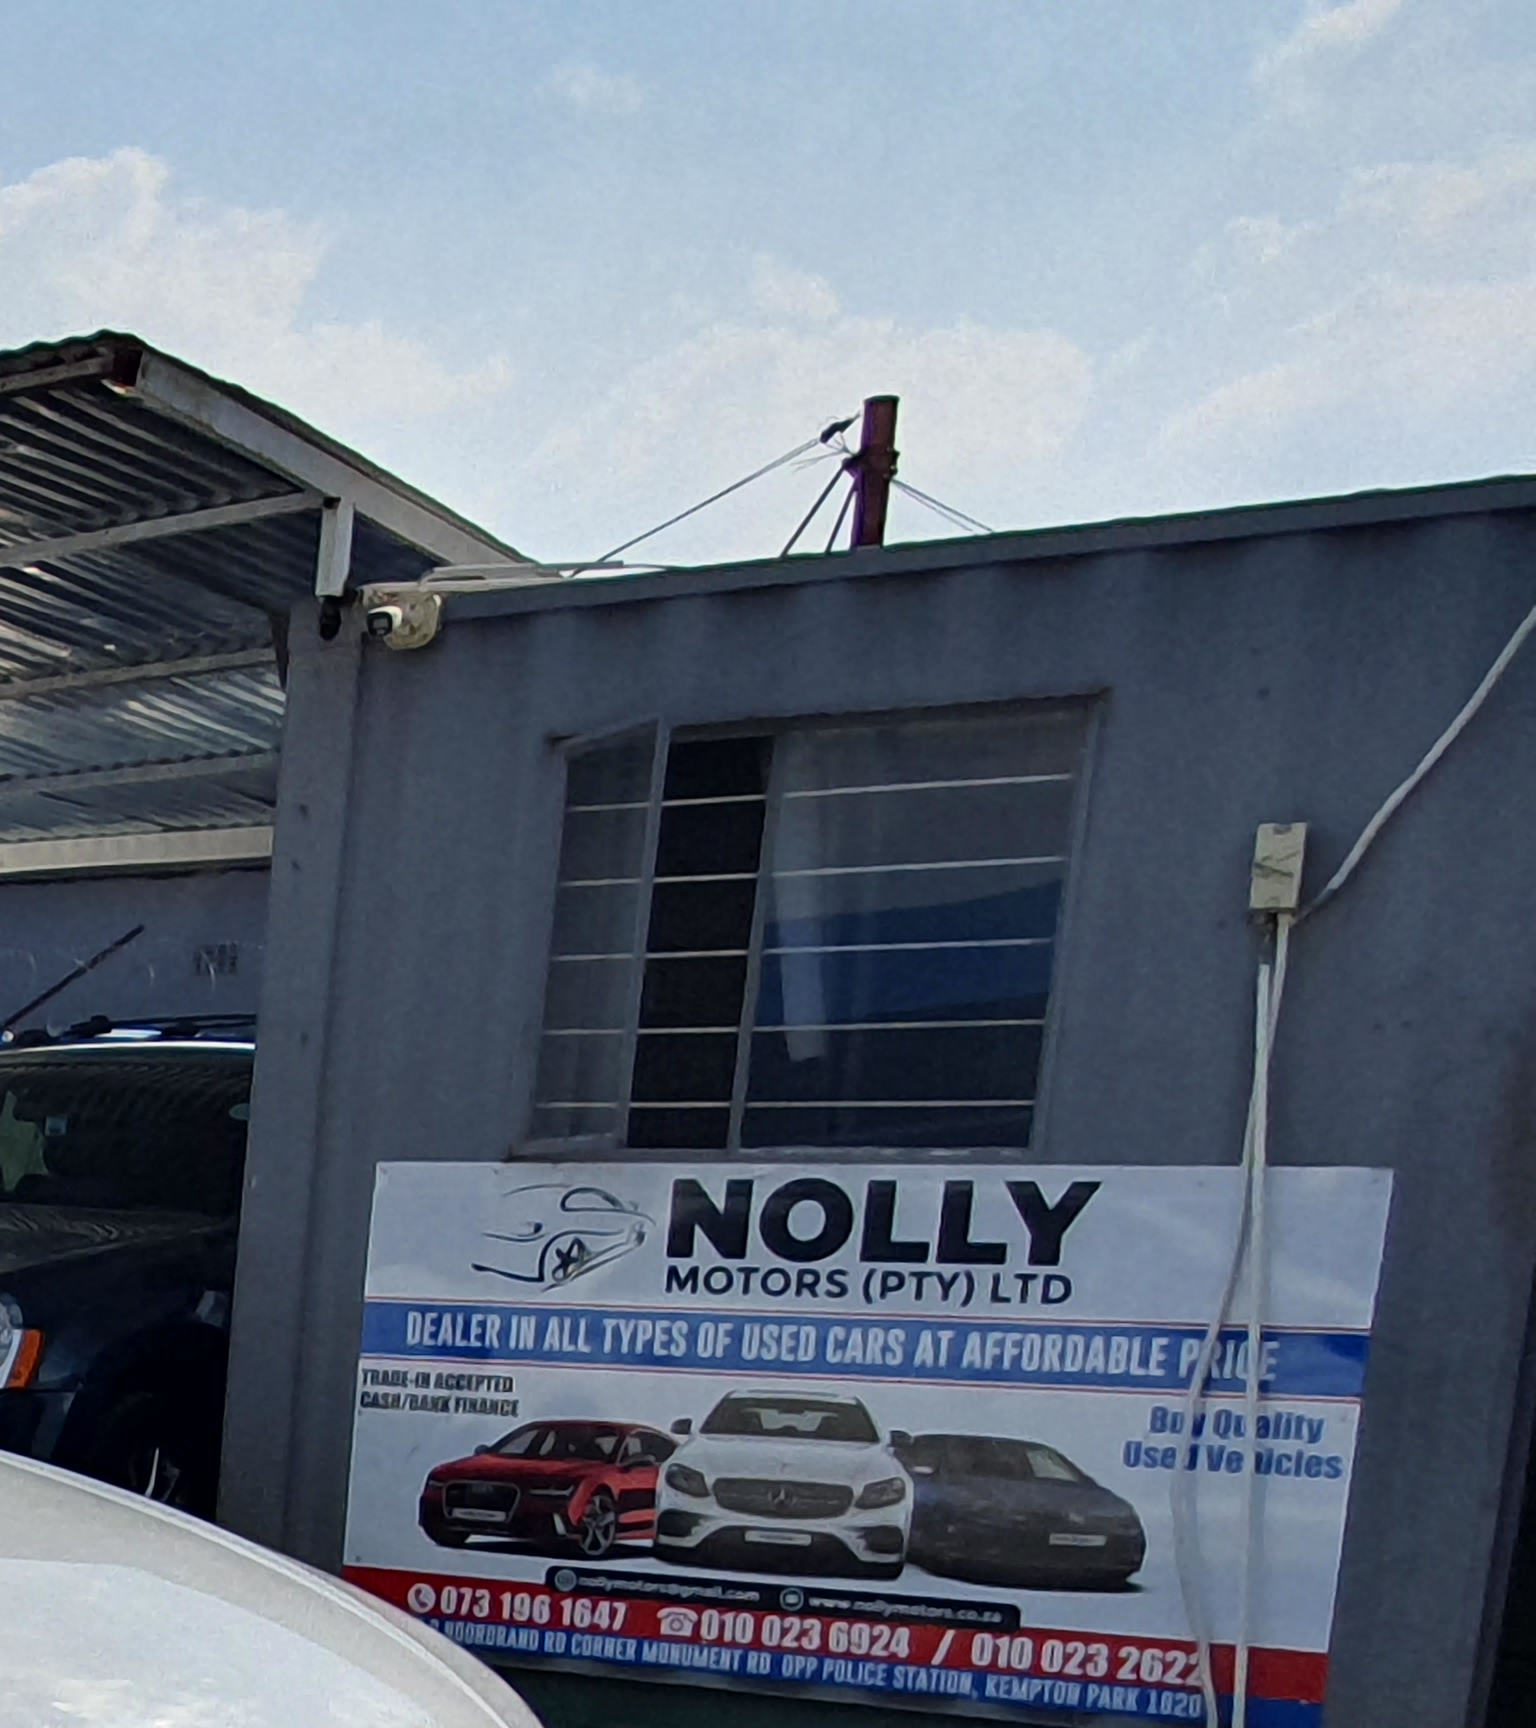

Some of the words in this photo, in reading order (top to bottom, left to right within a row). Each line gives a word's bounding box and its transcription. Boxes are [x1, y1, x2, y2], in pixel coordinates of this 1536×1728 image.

[666, 1178, 1102, 1266] NOLLY
[665, 1265, 848, 1299] MOTORS
[863, 1268, 975, 1307] (PTY)
[990, 1272, 1072, 1304] LTD
[406, 1311, 501, 1350] DEALER
[509, 1314, 536, 1351] IN
[539, 1316, 591, 1354] ALL
[603, 1318, 689, 1358] TYPES
[697, 1321, 733, 1359] OF
[741, 1323, 817, 1362] USED
[826, 1325, 906, 1366] CARS
[913, 1329, 956, 1368] AT
[961, 1331, 1170, 1376] AFFORDABLE
[362, 1368, 431, 1389] TRADE-IN
[434, 1372, 513, 1393] ACCEPTED
[360, 1391, 451, 1413] CASH/BANK
[453, 1396, 519, 1417] FINANCE
[1213, 1408, 1325, 1444] Quality
[440, 1586, 490, 1618] 073
[499, 1592, 551, 1624] 196
[560, 1597, 626, 1631] 1647
[700, 1608, 754, 1644] 010
[761, 1614, 822, 1650] 023
[829, 1620, 910, 1658] 6924
[971, 1633, 1033, 1669] 010
[1041, 1639, 1109, 1677] 023
[544, 1630, 566, 1654] RD
[572, 1634, 637, 1661] CORNER
[642, 1640, 740, 1671] MONUMENT
[747, 1650, 771, 1675] RD
[782, 1655, 818, 1680] OPP
[822, 1659, 887, 1687] POLICE
[893, 1665, 978, 1698] STATION,
[985, 1675, 1080, 1708] KEMPTON
[1085, 1683, 1138, 1711] PARK
